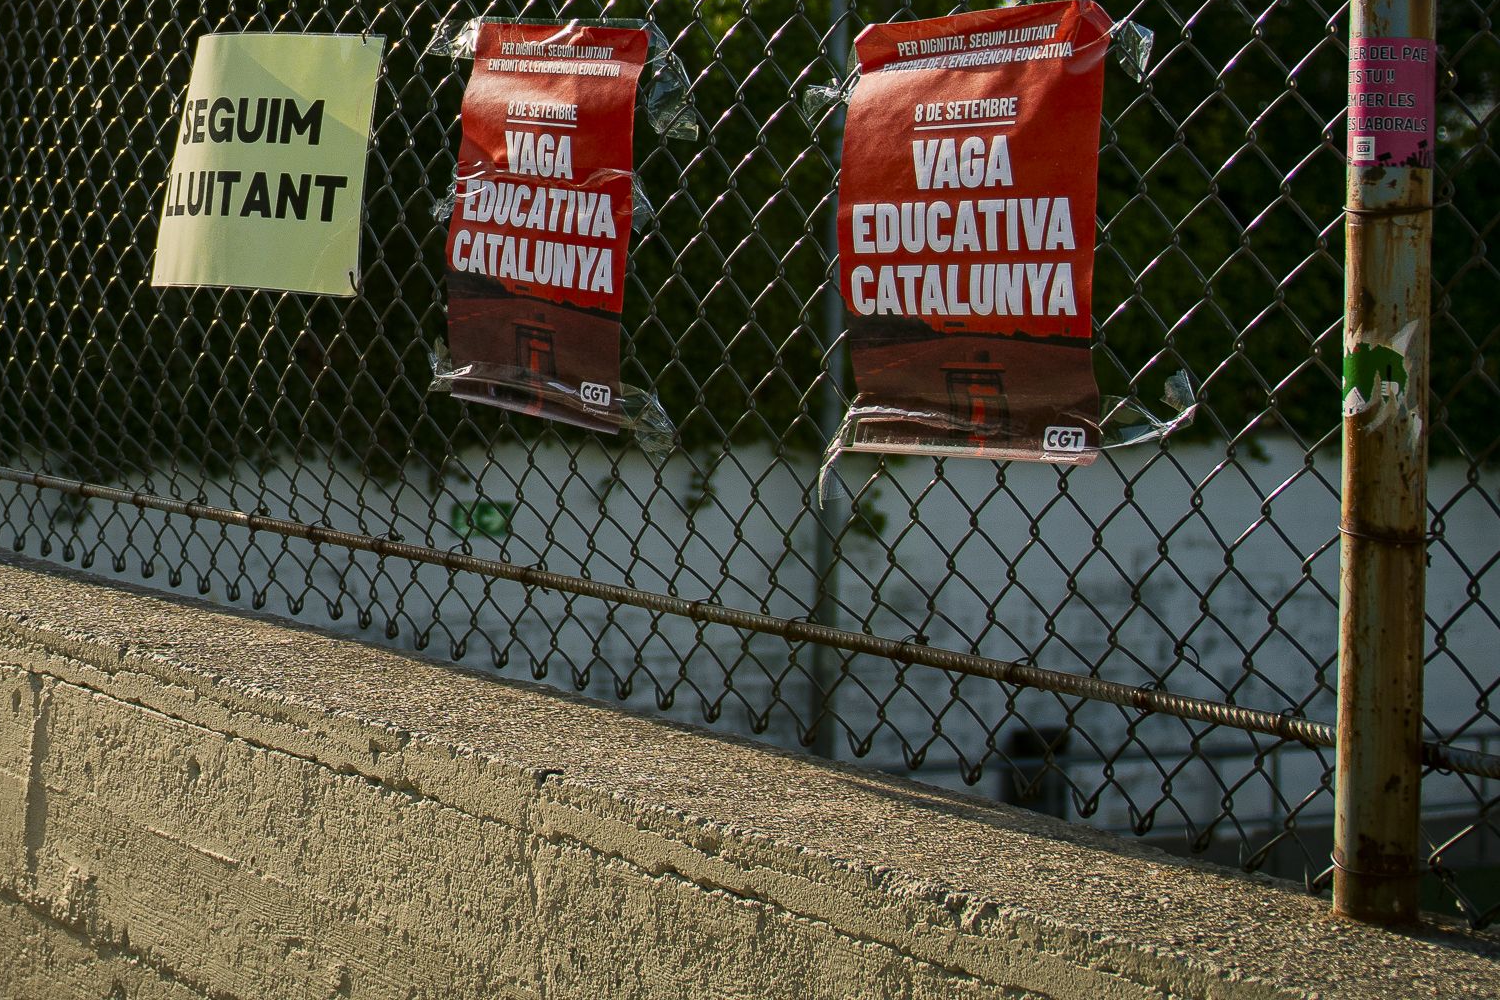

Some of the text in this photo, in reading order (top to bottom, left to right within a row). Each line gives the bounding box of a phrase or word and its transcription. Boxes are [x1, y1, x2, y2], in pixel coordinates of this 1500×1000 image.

[502, 42, 514, 55] PER
[576, 45, 613, 59] LLUITANT
[898, 24, 1058, 57] PER DIGNITAT, SEGUIM LLUITANT
[1370, 46, 1398, 60] DEL
[1402, 46, 1428, 62] PAE
[488, 58, 519, 72] ENFRONT
[579, 63, 620, 77] EDUCATIVA
[927, 57, 941, 70] DE
[1015, 42, 1073, 62] EDUCATIVA
[1365, 69, 1382, 83] TU
[507, 102, 577, 121] 8 DE SETEMBRE
[914, 96, 1018, 123] 8 DE SETEMBRE
[1359, 93, 1384, 107] PER
[1388, 93, 1415, 107] LES
[182, 96, 325, 145] SEGUIM
[1358, 117, 1428, 132] LABORALS
[505, 130, 573, 180] VAGA
[912, 134, 1014, 190] VAGA
[166, 170, 348, 222] LLUITANT
[462, 179, 617, 240] EDUCATIVA
[852, 197, 1076, 254] EDUCATIVA
[452, 229, 614, 294] CATALUNYA
[851, 262, 1077, 317] CATALUNYA
[582, 385, 609, 403] CGT
[1047, 429, 1083, 448] CGT
